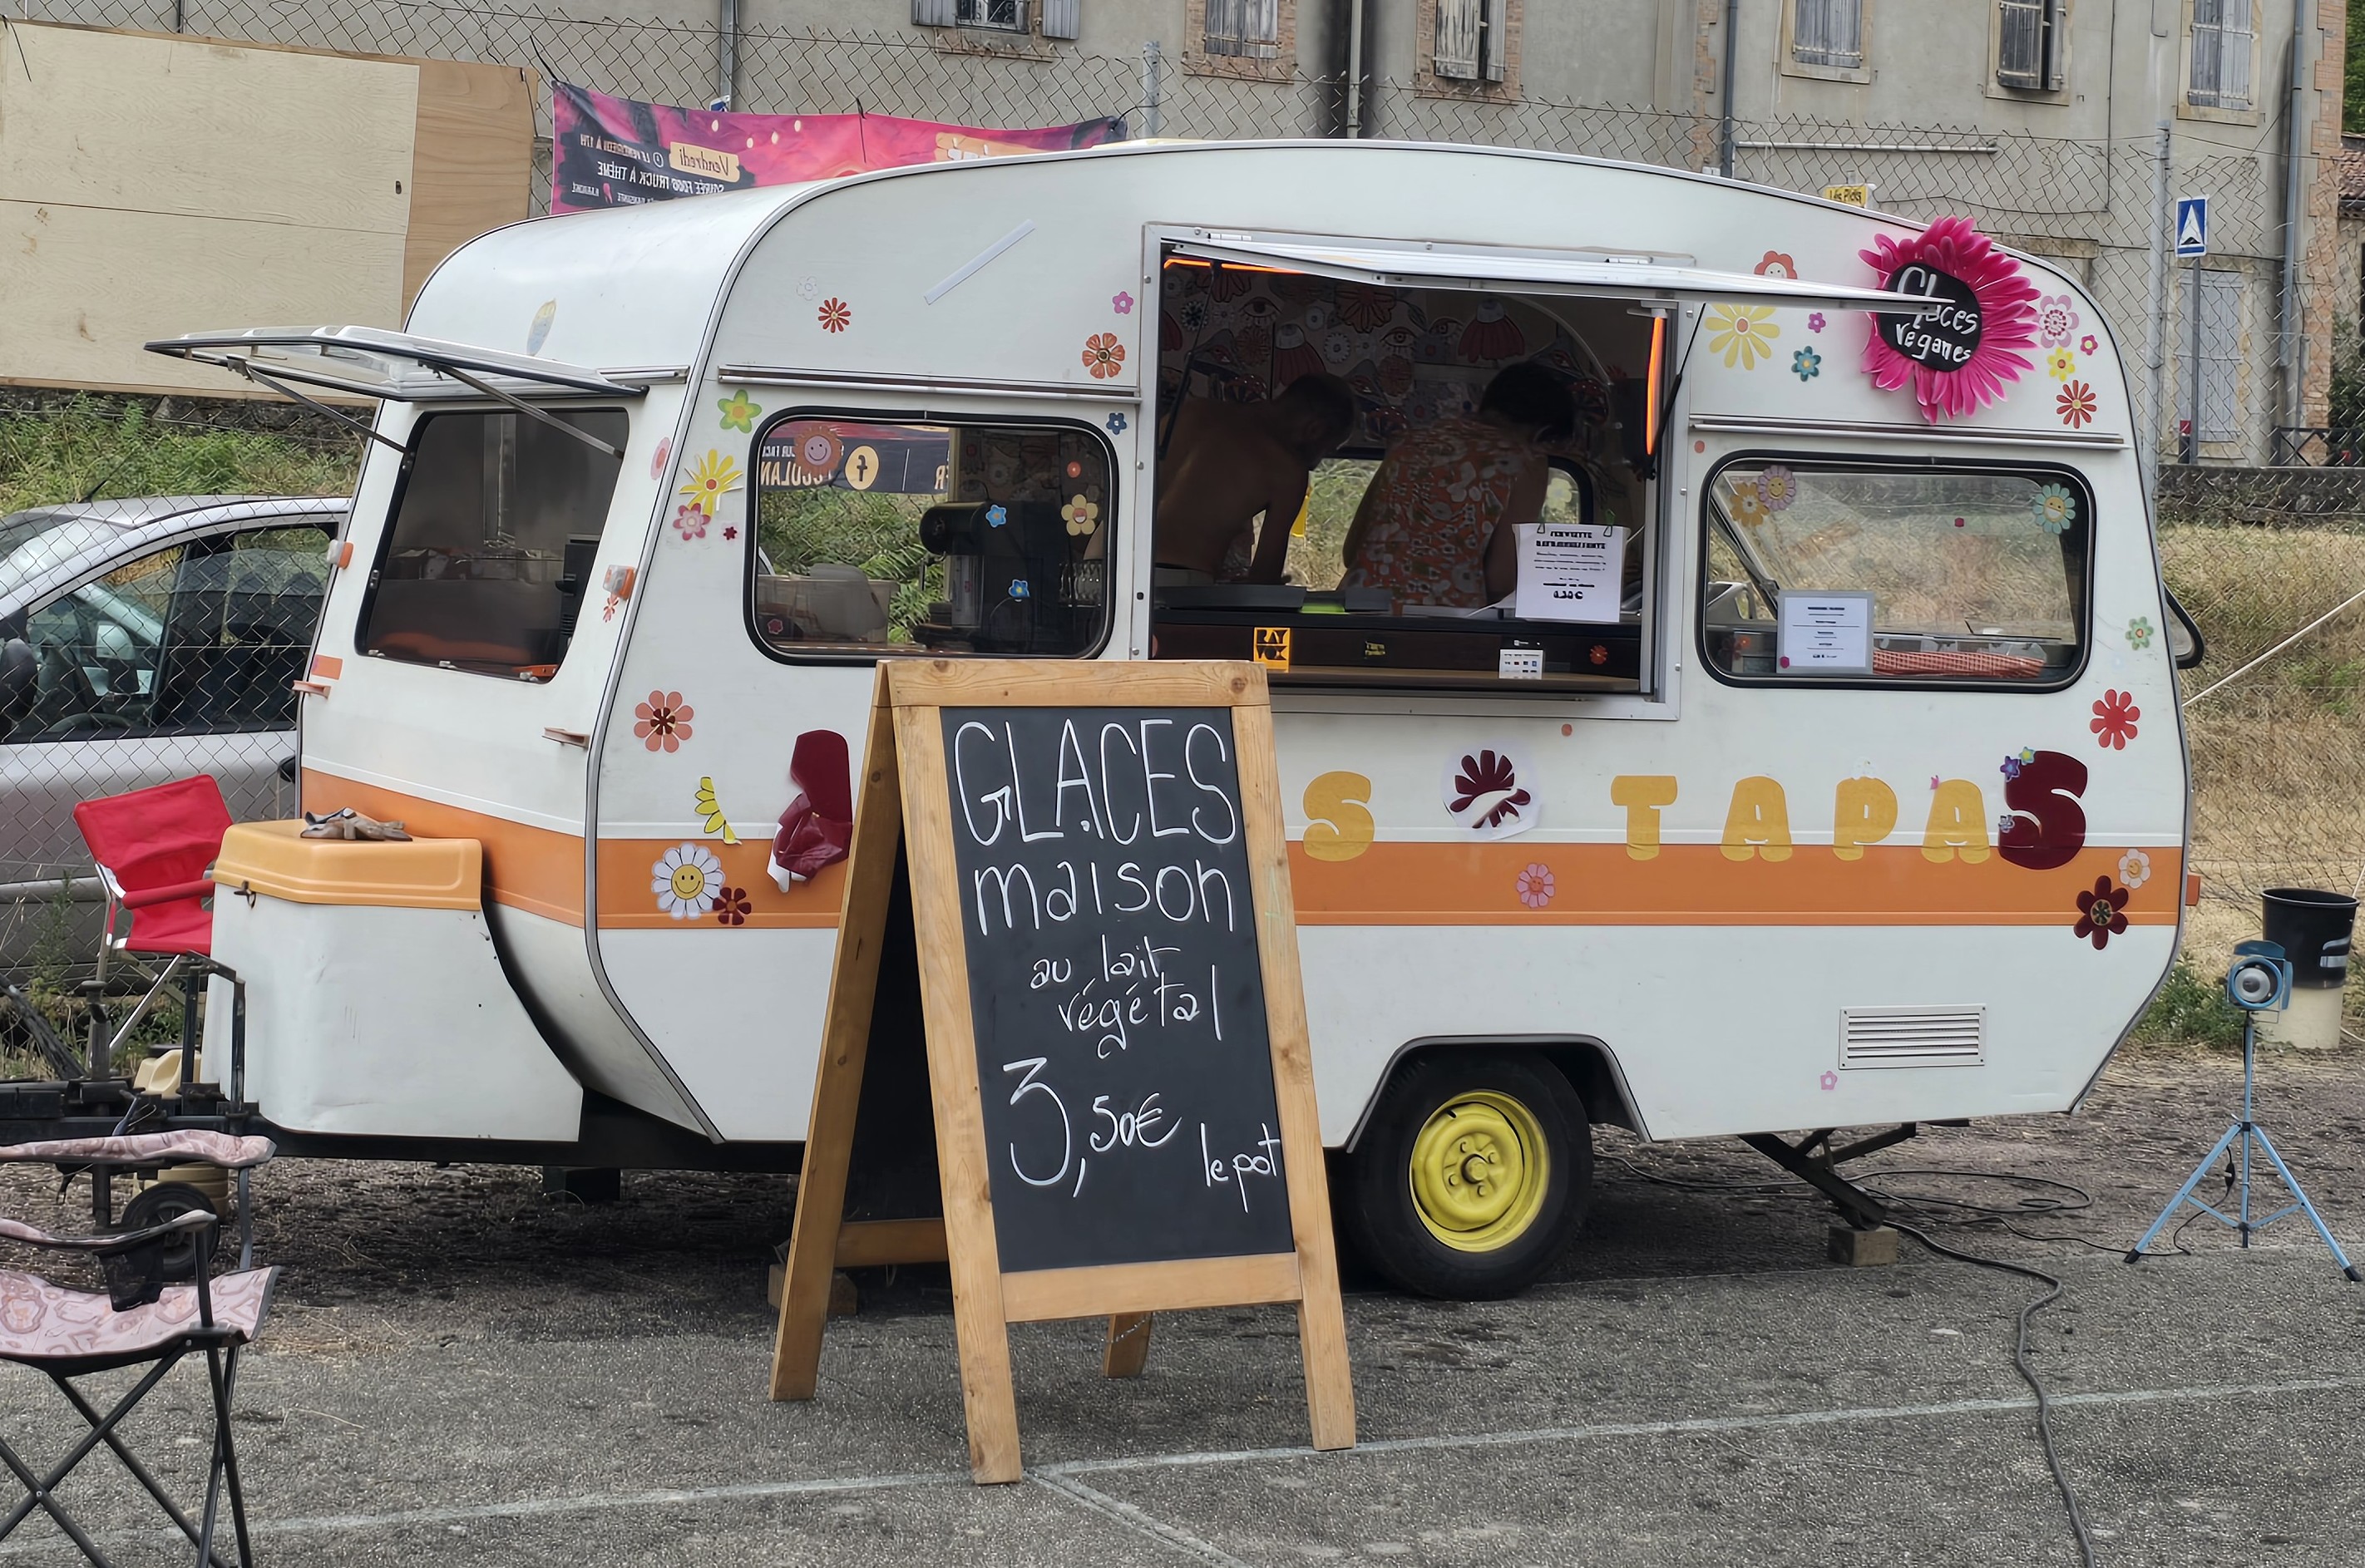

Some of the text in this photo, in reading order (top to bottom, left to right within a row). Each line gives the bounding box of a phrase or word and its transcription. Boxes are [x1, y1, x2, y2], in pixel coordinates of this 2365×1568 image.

[1257, 629, 1287, 643] RAY
[1257, 646, 1287, 660] VOX
[954, 718, 1237, 846] GLACES
[1611, 750, 2089, 871] TAPAS
[974, 859, 1234, 936] maison
[1030, 934, 1181, 989] au lait
[1058, 964, 1222, 1059] végétal
[1003, 1057, 1183, 1198] 3,50€
[1201, 1122, 1281, 1213] le pot
